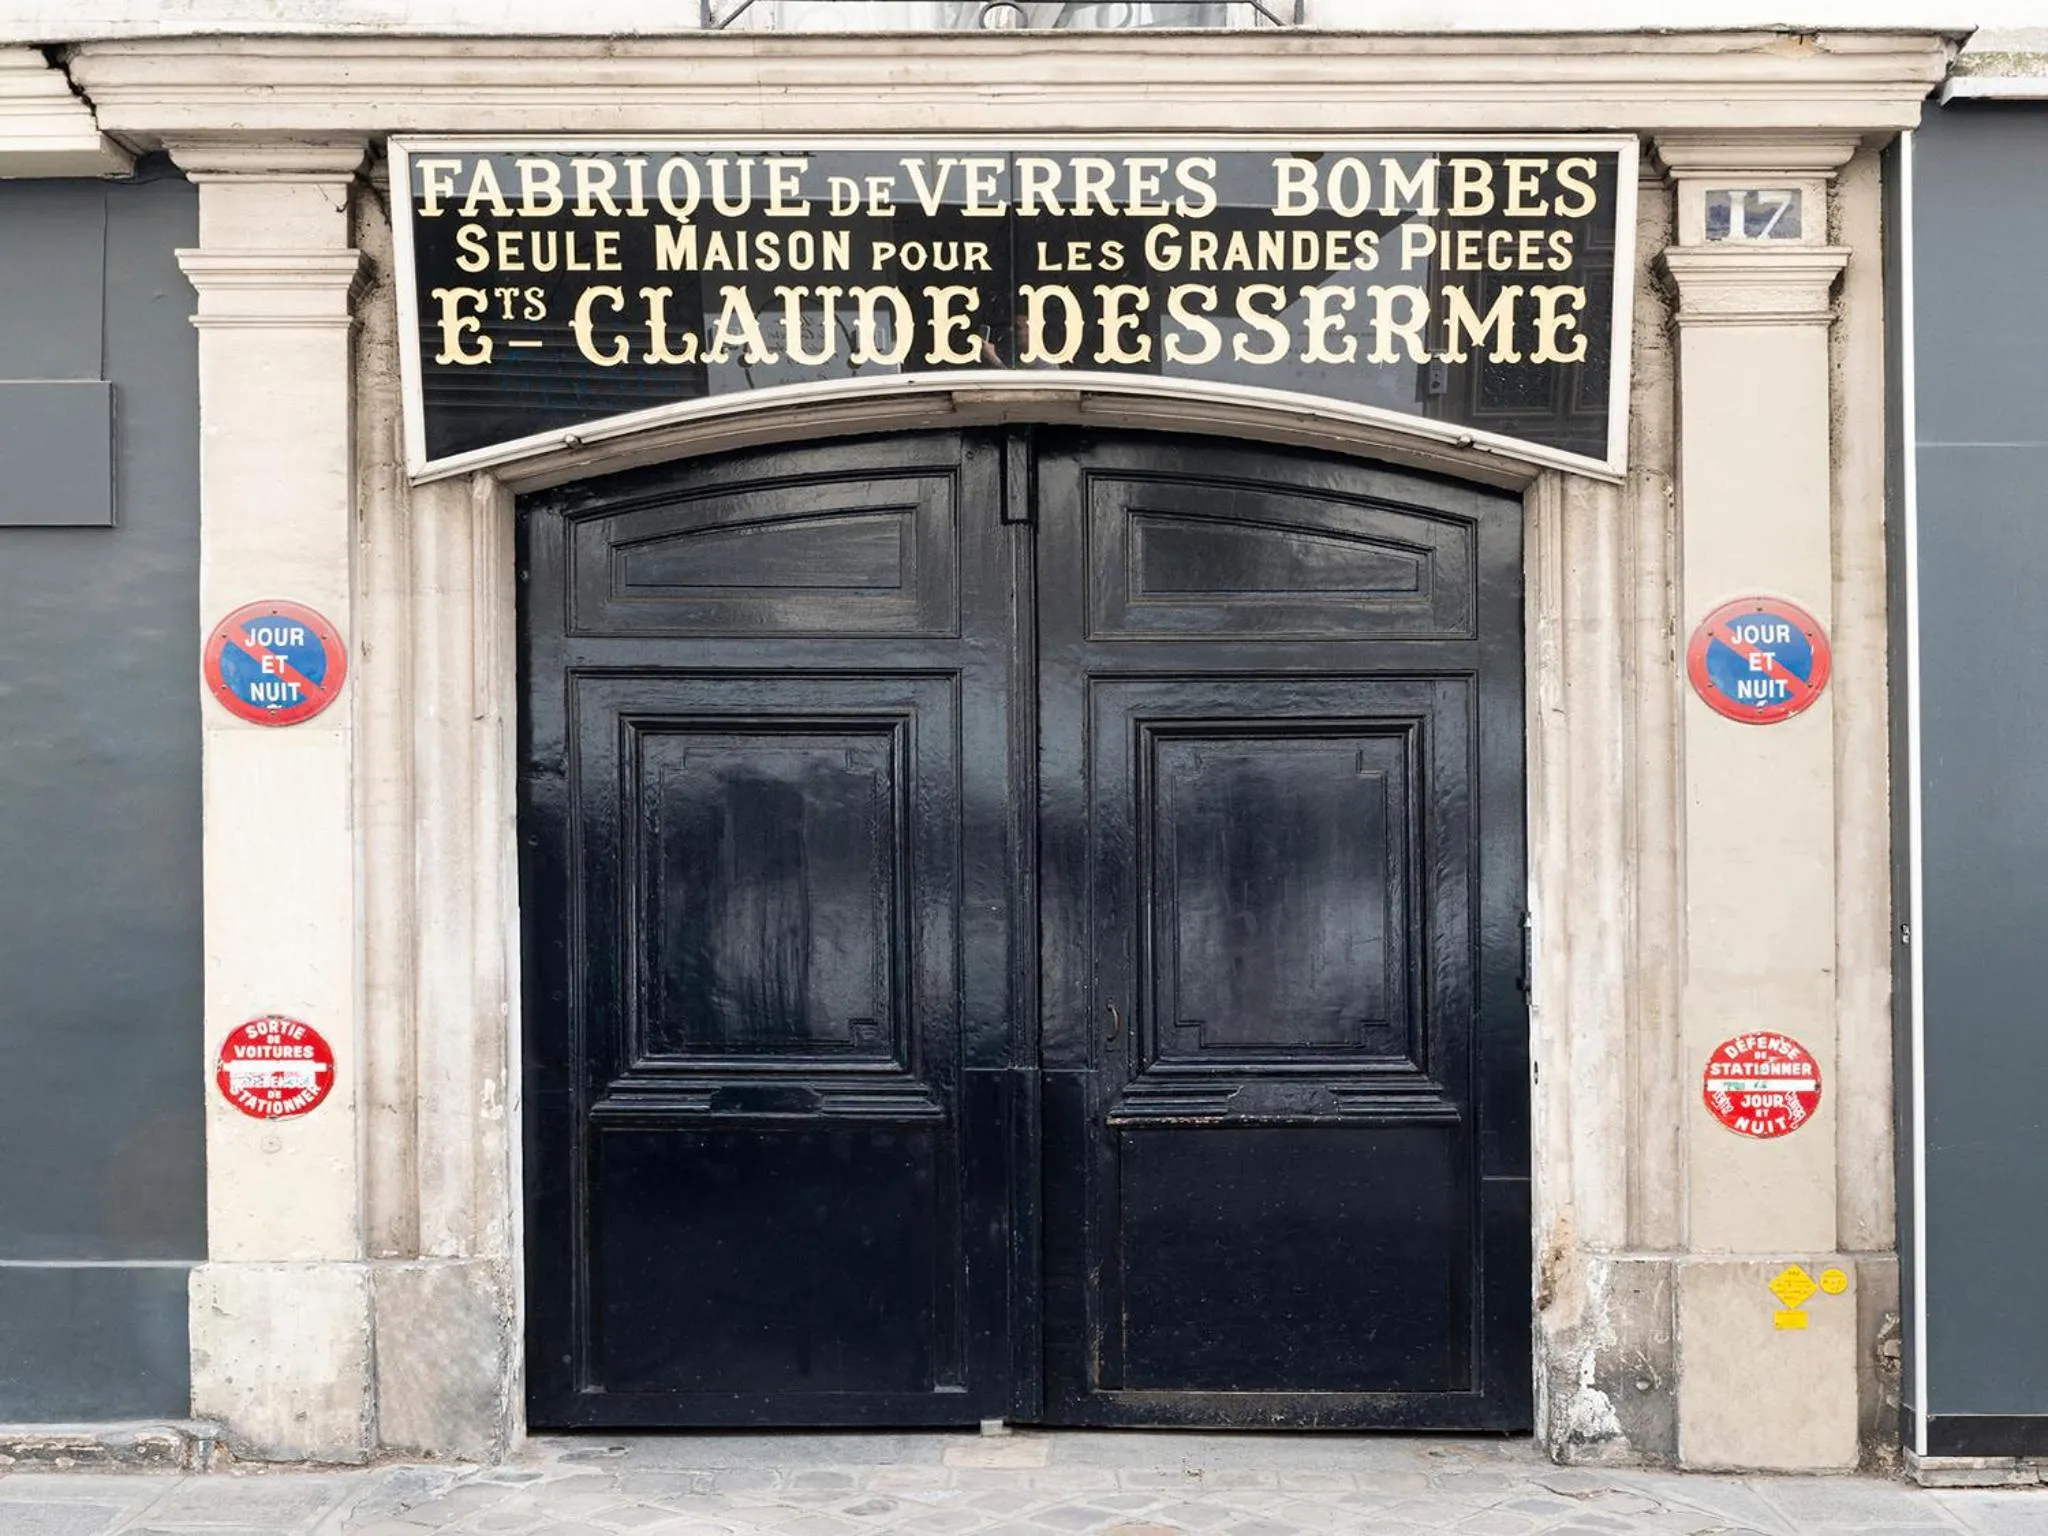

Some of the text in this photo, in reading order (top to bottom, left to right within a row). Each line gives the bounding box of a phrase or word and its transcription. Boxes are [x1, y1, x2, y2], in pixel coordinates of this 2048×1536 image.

[416, 156, 1598, 224] FABRIQUE DE VERRES BOMBES
[1727, 190, 1793, 240] 17
[456, 223, 1574, 273] SEULE MAISON POUR LES GRANDES PIECES
[568, 285, 983, 367] CLAUDE
[1018, 284, 1588, 366] DESSERME
[244, 627, 305, 647] JOUR
[1731, 624, 1791, 644] JOUR
[261, 655, 289, 674] ET
[1748, 652, 1776, 671] ET
[250, 682, 301, 701] NUIT
[1737, 680, 1788, 699] NUIT
[244, 1020, 306, 1040] SORTIE
[267, 1035, 281, 1044] DE
[233, 1045, 315, 1059] VOITURES
[1754, 1051, 1768, 1060] DE
[1709, 1062, 1813, 1075] STATIONNER
[229, 1085, 322, 1114] STATIONNER
[267, 1090, 282, 1099] DE
[1740, 1094, 1784, 1108] JOUR
[1754, 1108, 1769, 1118] ET
[1734, 1116, 1787, 1134] NUIT
